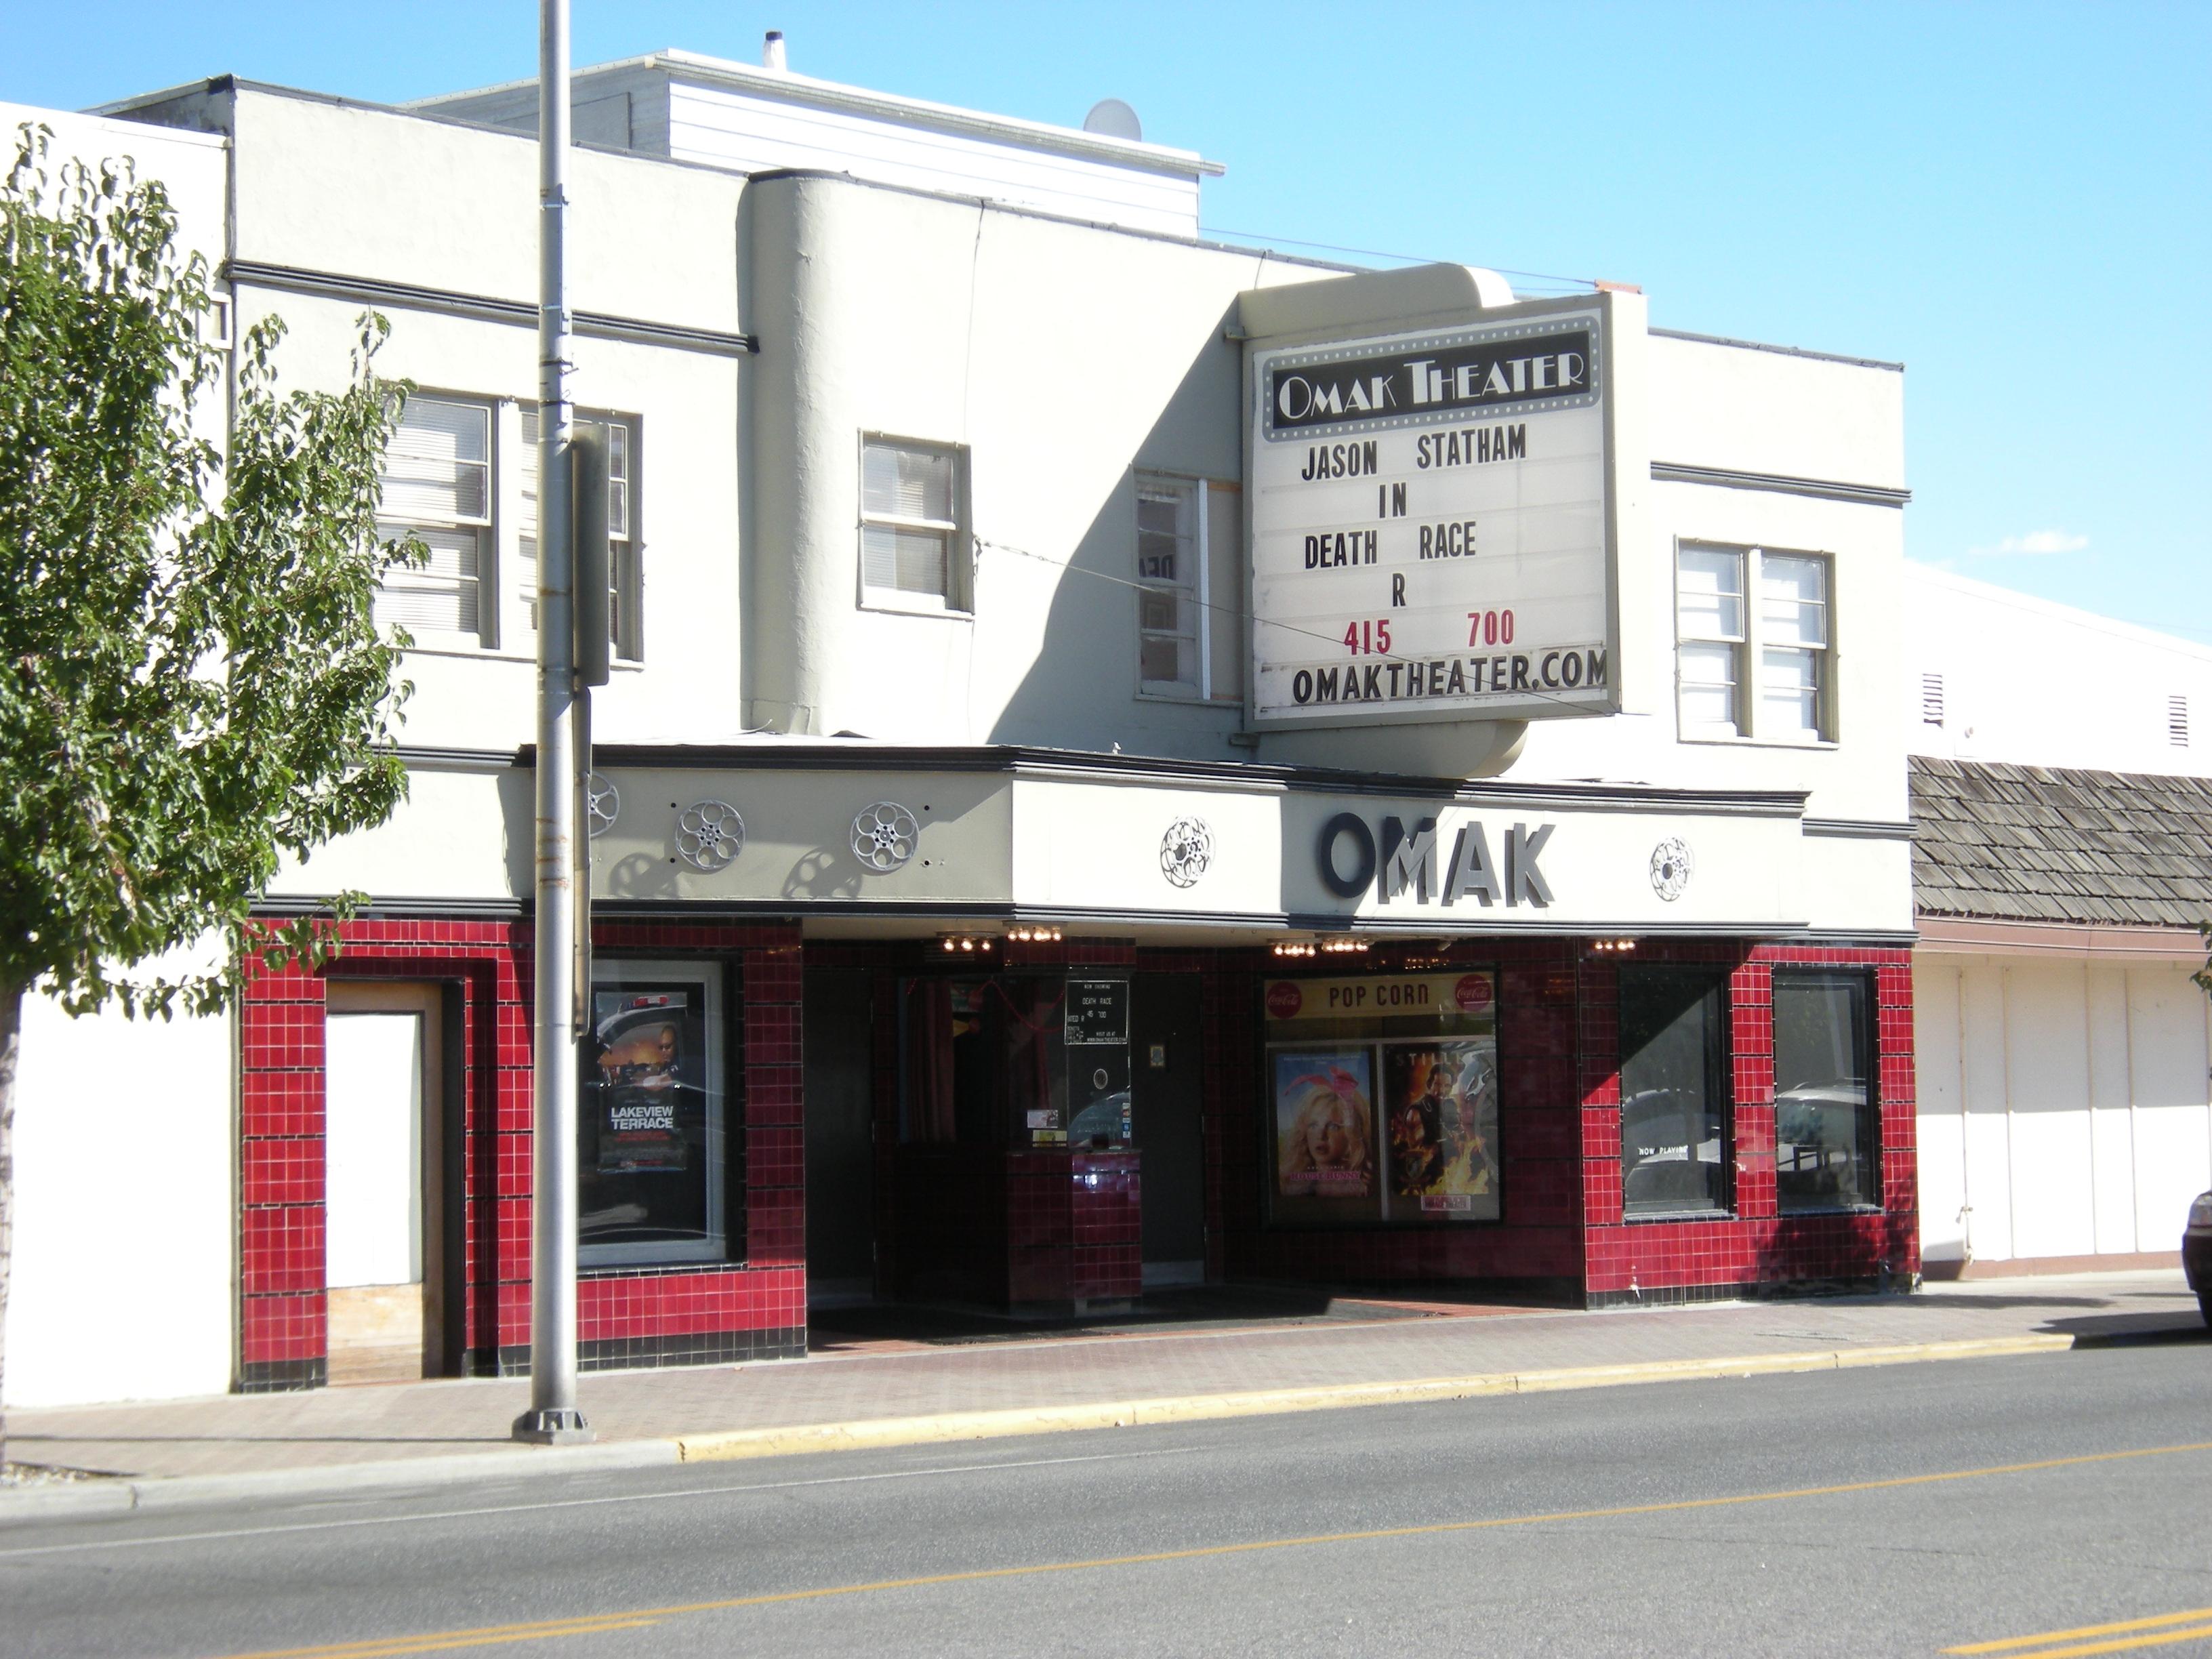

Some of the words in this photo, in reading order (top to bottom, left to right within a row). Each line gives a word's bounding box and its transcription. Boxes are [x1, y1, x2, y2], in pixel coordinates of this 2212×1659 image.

[1279, 375, 1397, 419] OMAK
[1404, 352, 1584, 404] THEATER
[1301, 440, 1378, 481] JASON
[1417, 423, 1527, 470] STATHAM
[1378, 482, 1407, 518] IN
[1305, 529, 1378, 569] DEATH
[1420, 521, 1477, 560] RACE
[1393, 573, 1406, 607] R
[1343, 619, 1391, 655] 415
[1467, 609, 1515, 647] 700
[1292, 649, 1608, 704] OMAKTHEATER.COM
[1320, 812, 1557, 904] OMAK
[1329, 985, 1367, 1008] POP
[1376, 983, 1429, 1006] CORN
[611, 1105, 674, 1118] LAKEVIEW
[611, 1117, 674, 1130] TERRACE
[1639, 1147, 1655, 1155] NOW
